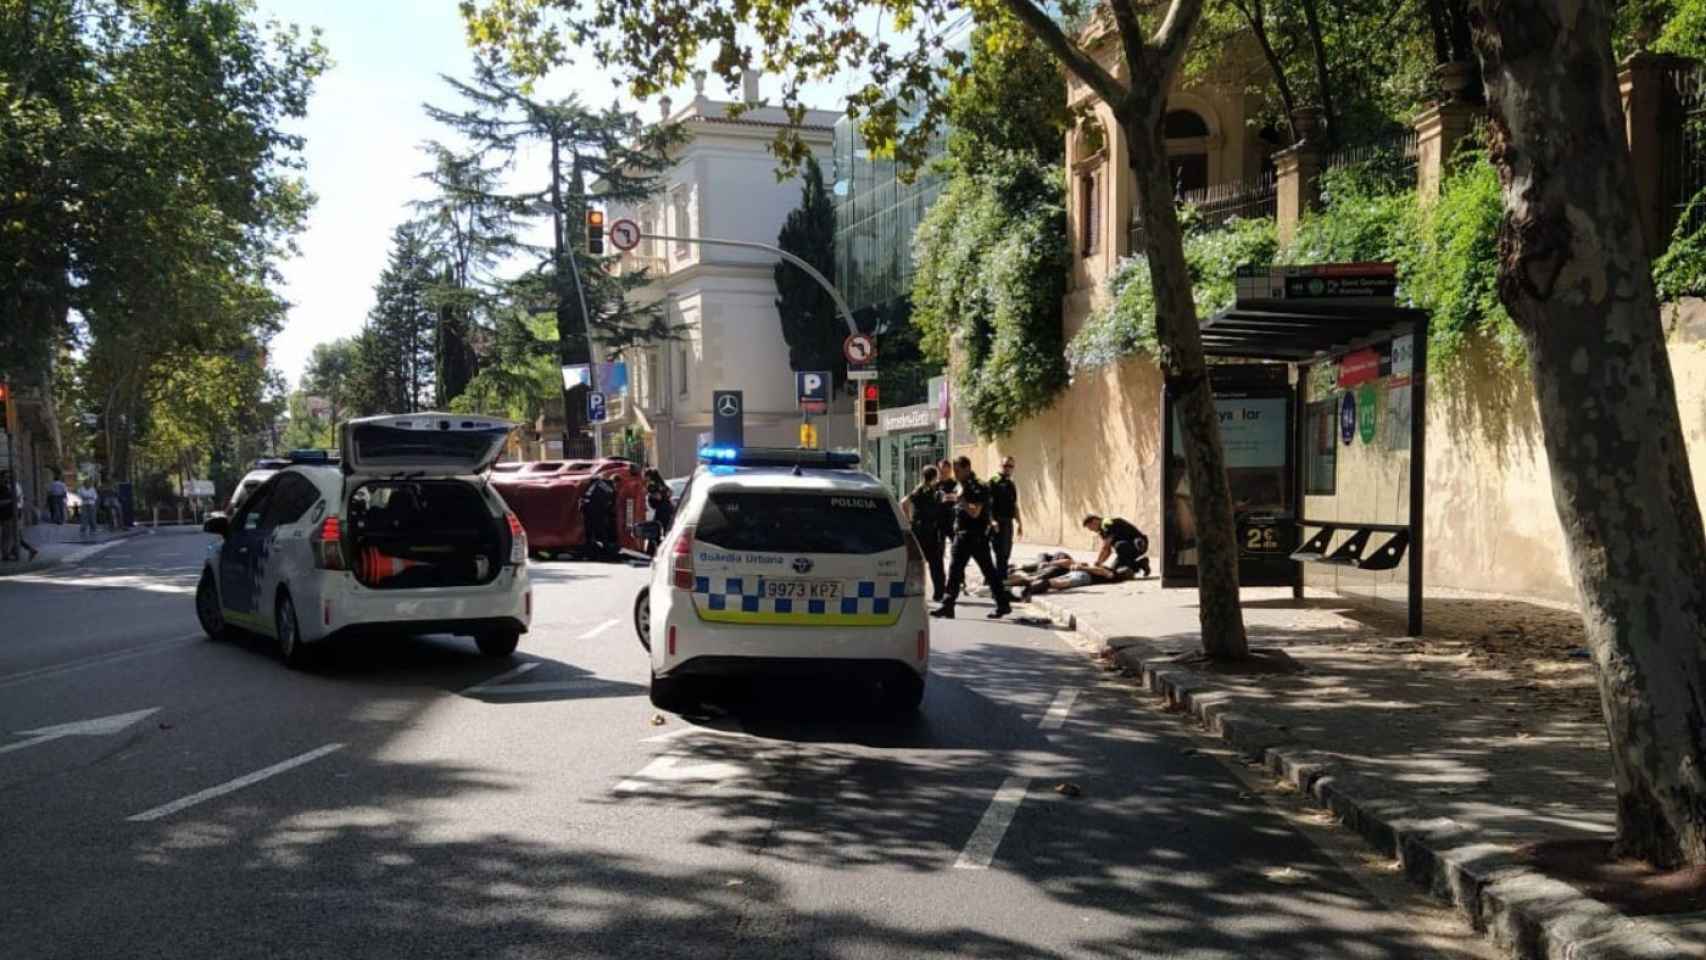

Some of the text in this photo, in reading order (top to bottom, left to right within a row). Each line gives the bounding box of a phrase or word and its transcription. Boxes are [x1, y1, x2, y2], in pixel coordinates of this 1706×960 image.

[804, 373, 821, 395] P
[590, 394, 603, 410] P
[767, 582, 841, 598] 9973 KPZ
